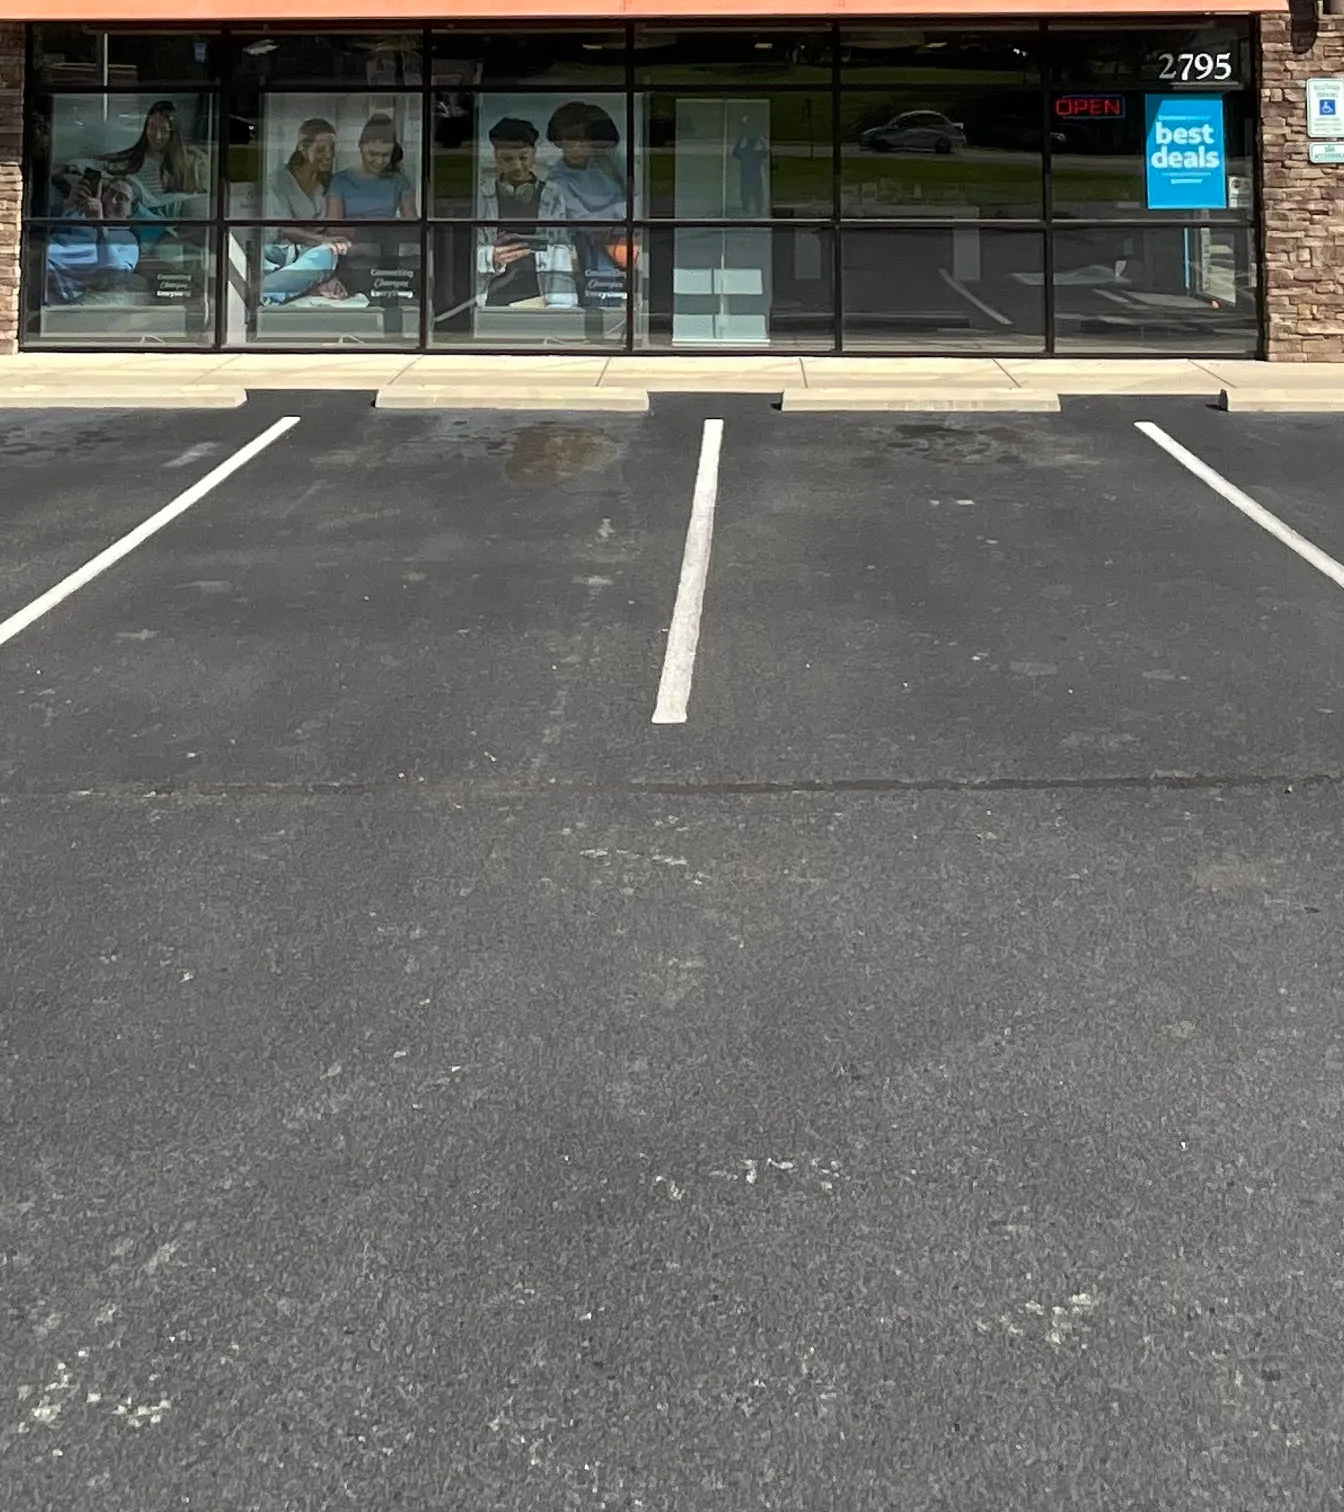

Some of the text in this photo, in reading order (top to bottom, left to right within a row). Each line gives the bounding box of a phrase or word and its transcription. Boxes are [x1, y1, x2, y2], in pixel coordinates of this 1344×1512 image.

[1158, 53, 1232, 80] 2795
[1056, 99, 1121, 115] OPEN
[1156, 121, 1215, 144] best
[1151, 145, 1220, 169] deals
